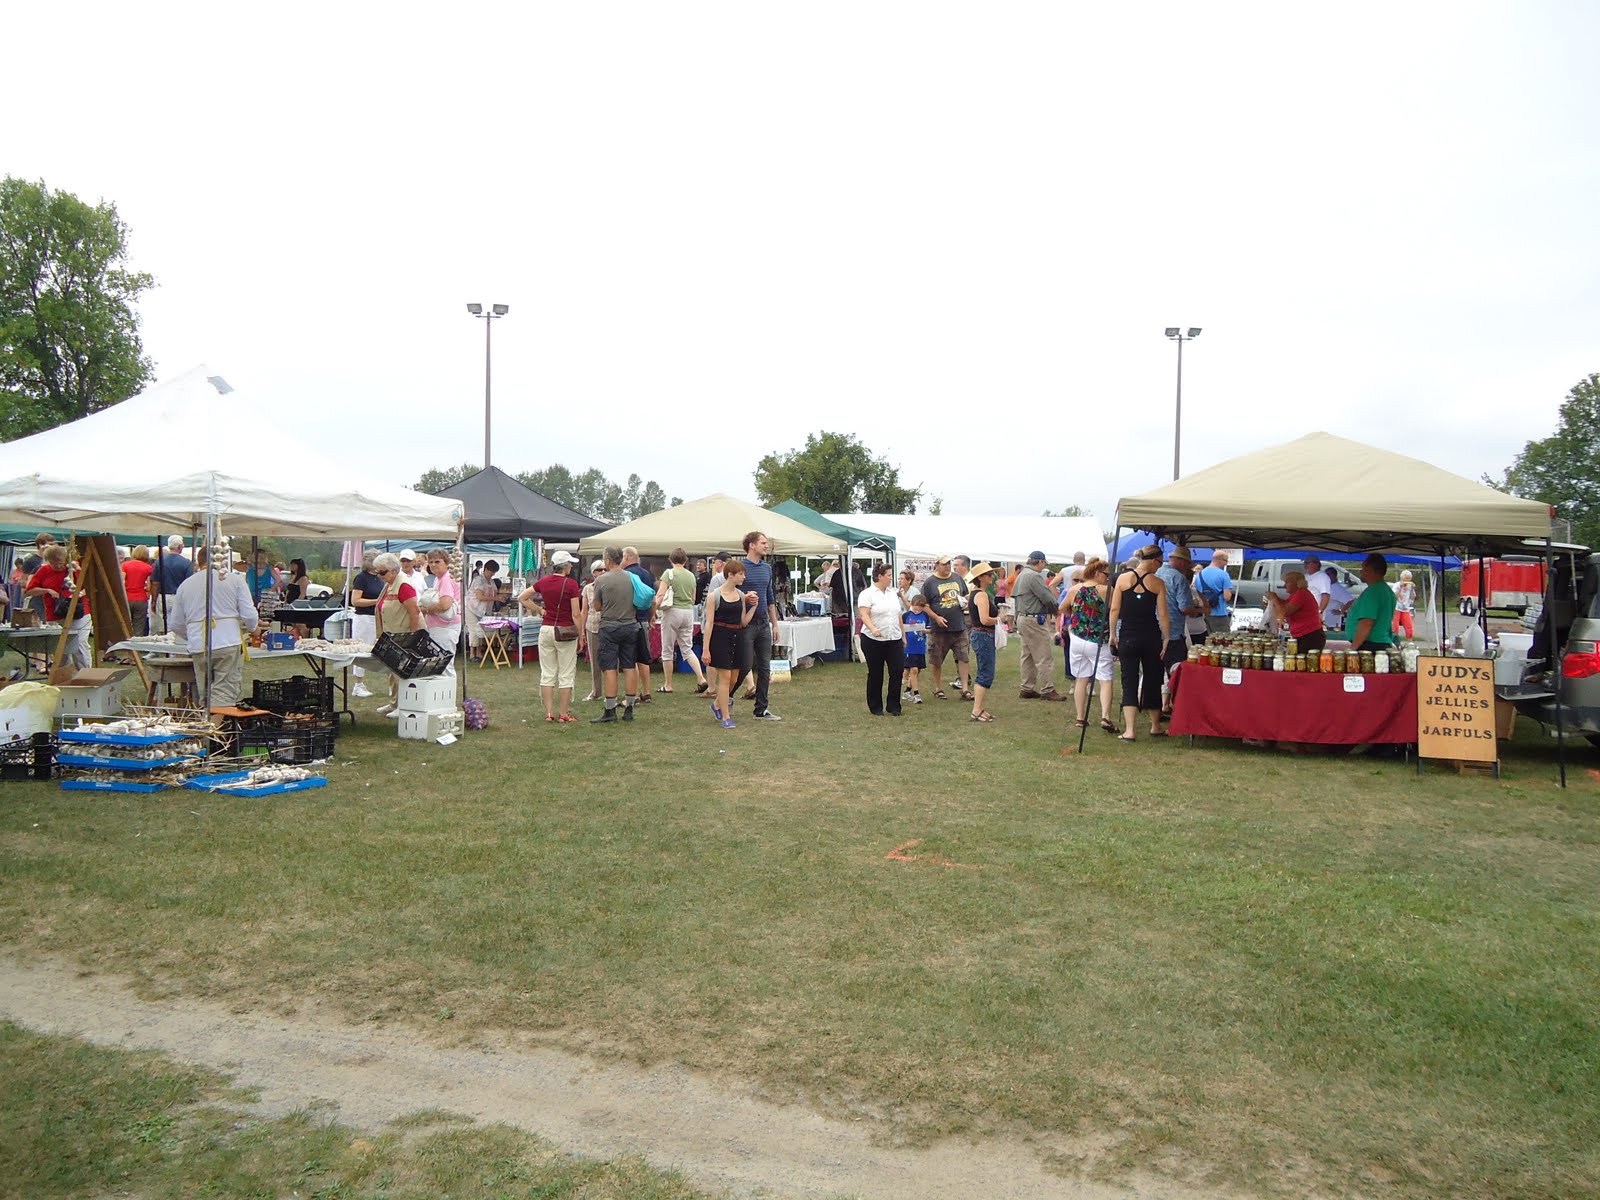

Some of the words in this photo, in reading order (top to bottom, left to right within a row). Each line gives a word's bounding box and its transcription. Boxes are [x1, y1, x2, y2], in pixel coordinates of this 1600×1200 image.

[1436, 684, 1479, 695] JAMS
[1426, 697, 1489, 709] JELLIES
[1440, 711, 1473, 722] AND
[1423, 726, 1492, 739] JARFULS
